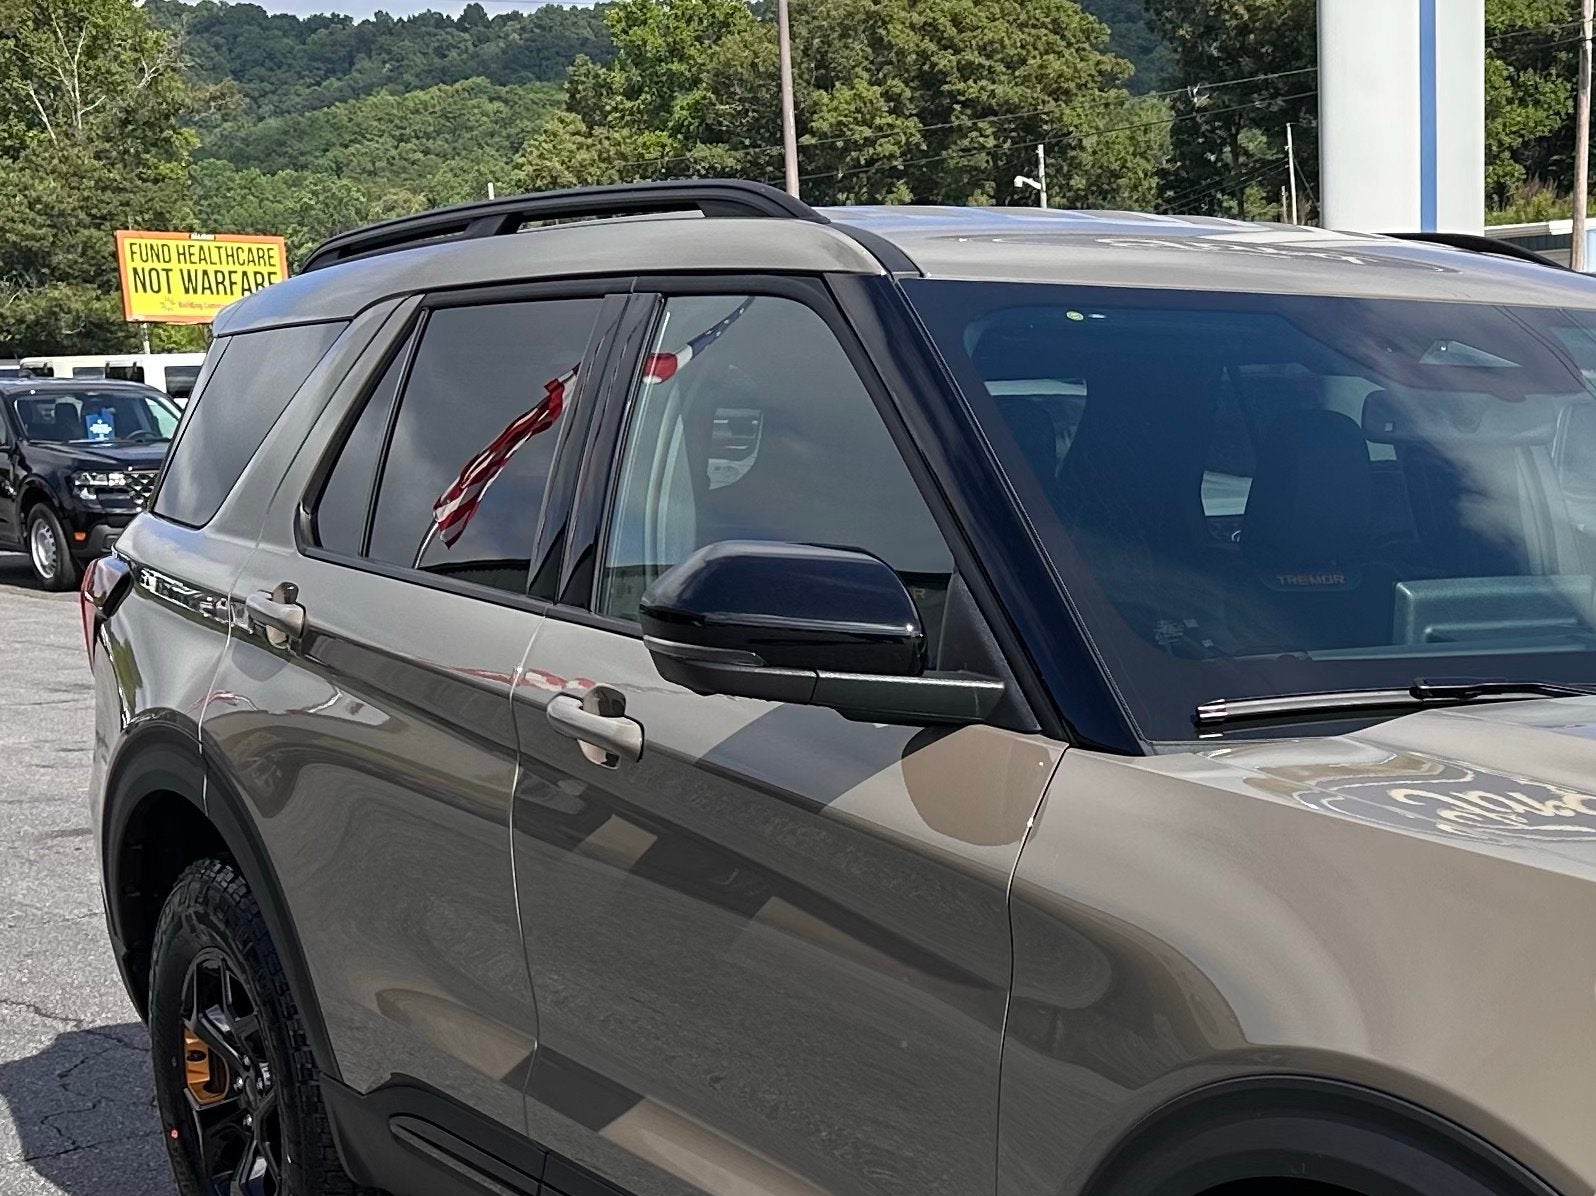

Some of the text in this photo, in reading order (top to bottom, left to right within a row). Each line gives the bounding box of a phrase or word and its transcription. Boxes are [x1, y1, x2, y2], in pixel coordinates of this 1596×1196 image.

[129, 242, 277, 267] FUND HEALTHCARE
[132, 267, 172, 294] NOT
[1277, 574, 1345, 585] TREMOR
